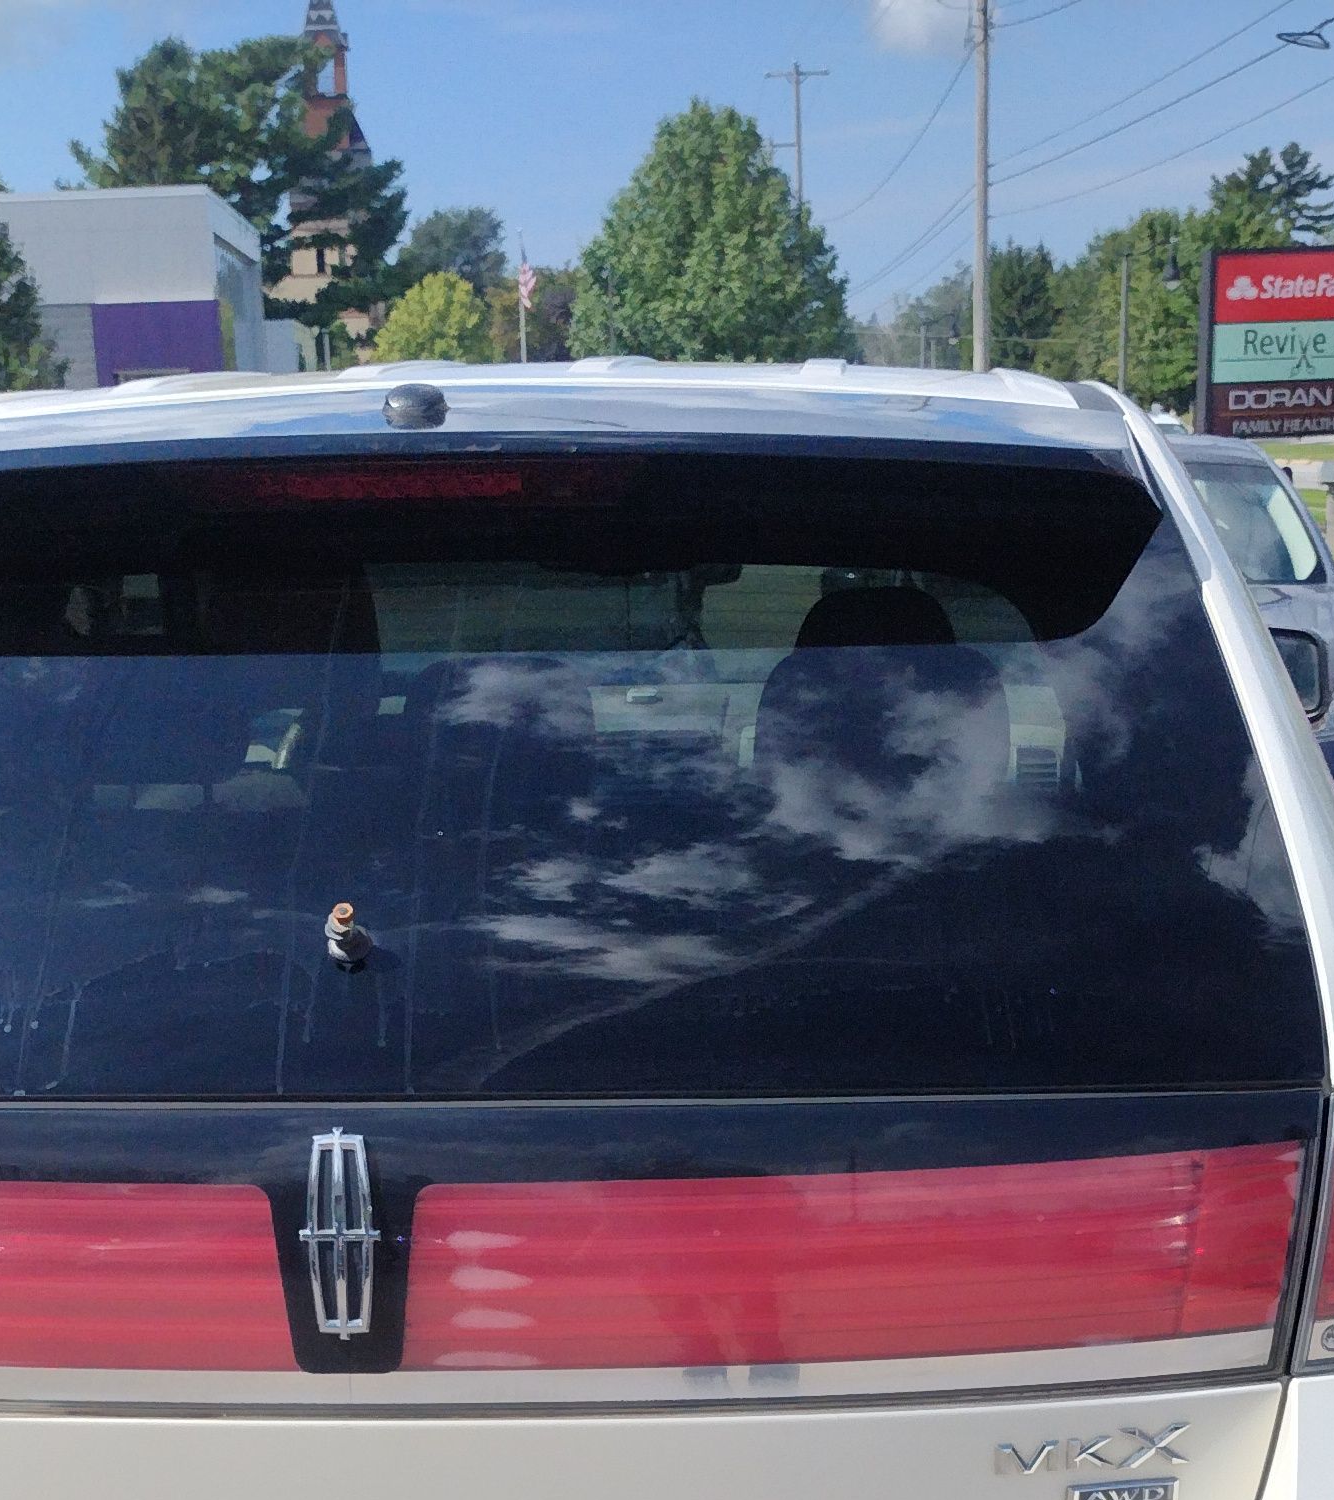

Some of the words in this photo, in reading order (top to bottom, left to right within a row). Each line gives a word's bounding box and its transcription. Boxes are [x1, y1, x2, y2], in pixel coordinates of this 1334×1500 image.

[1243, 326, 1327, 356] Revive
[1228, 386, 1333, 410] DORAN
[1232, 419, 1282, 435] FAMILY
[994, 1421, 1191, 1475] MKX
